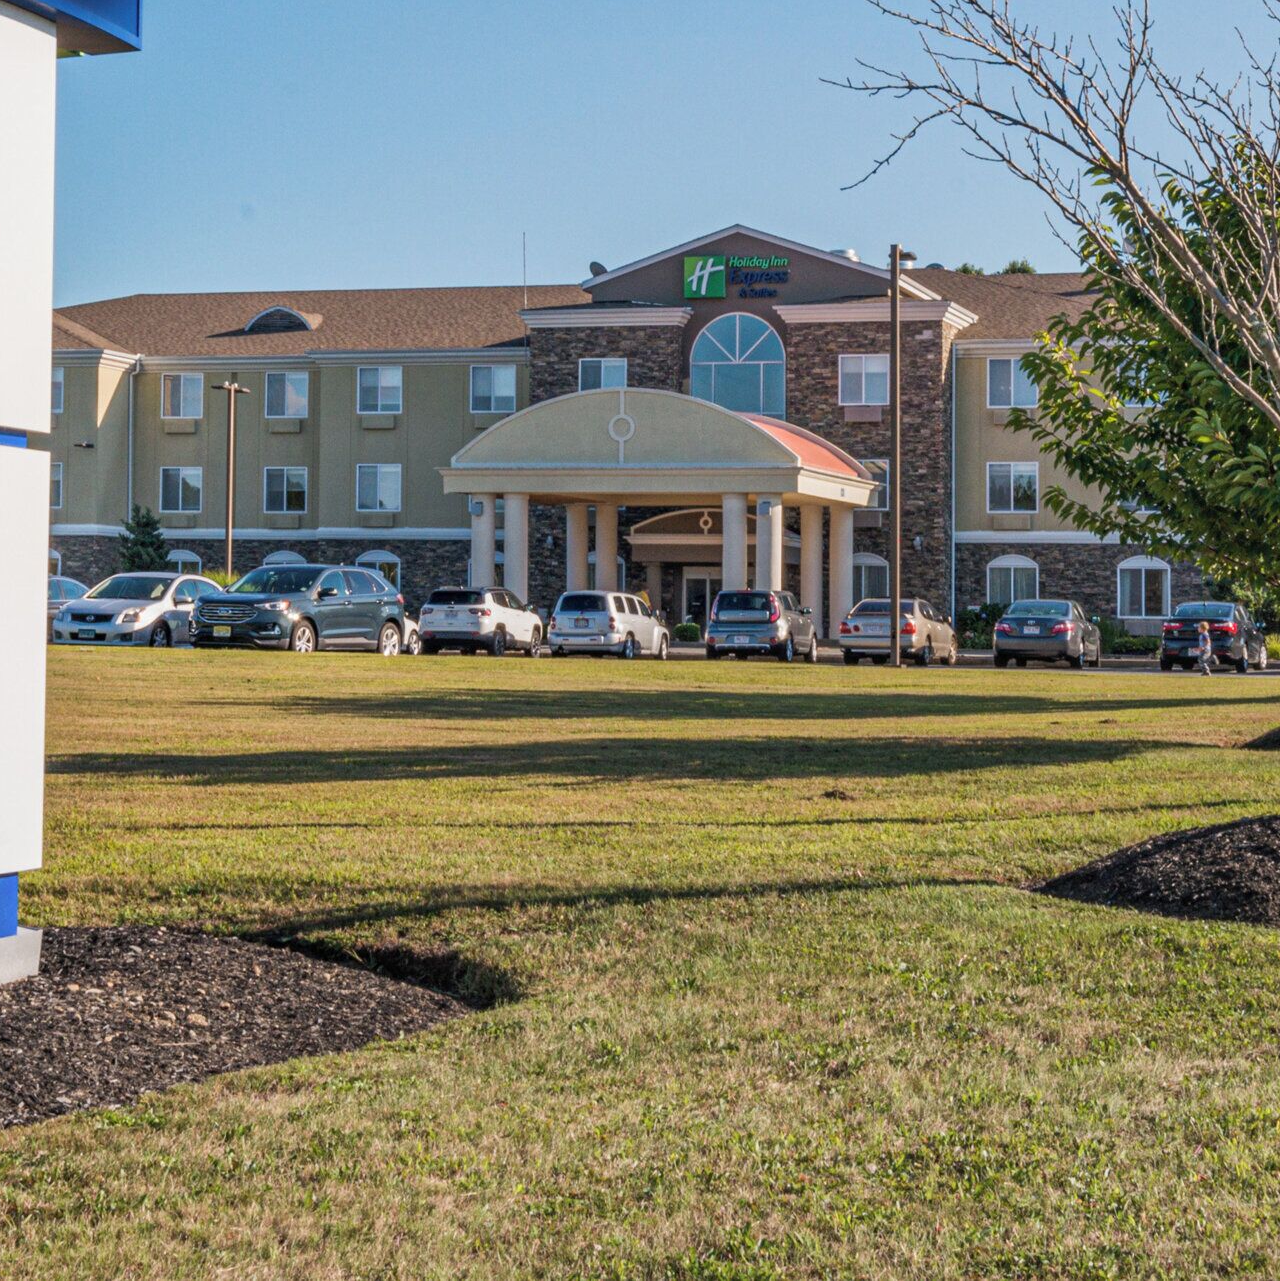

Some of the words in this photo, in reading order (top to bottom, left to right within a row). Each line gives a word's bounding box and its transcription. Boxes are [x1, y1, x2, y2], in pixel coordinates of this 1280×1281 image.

[729, 255, 770, 269] Holiday
[770, 255, 788, 267] Inn
[730, 269, 788, 287] Express
